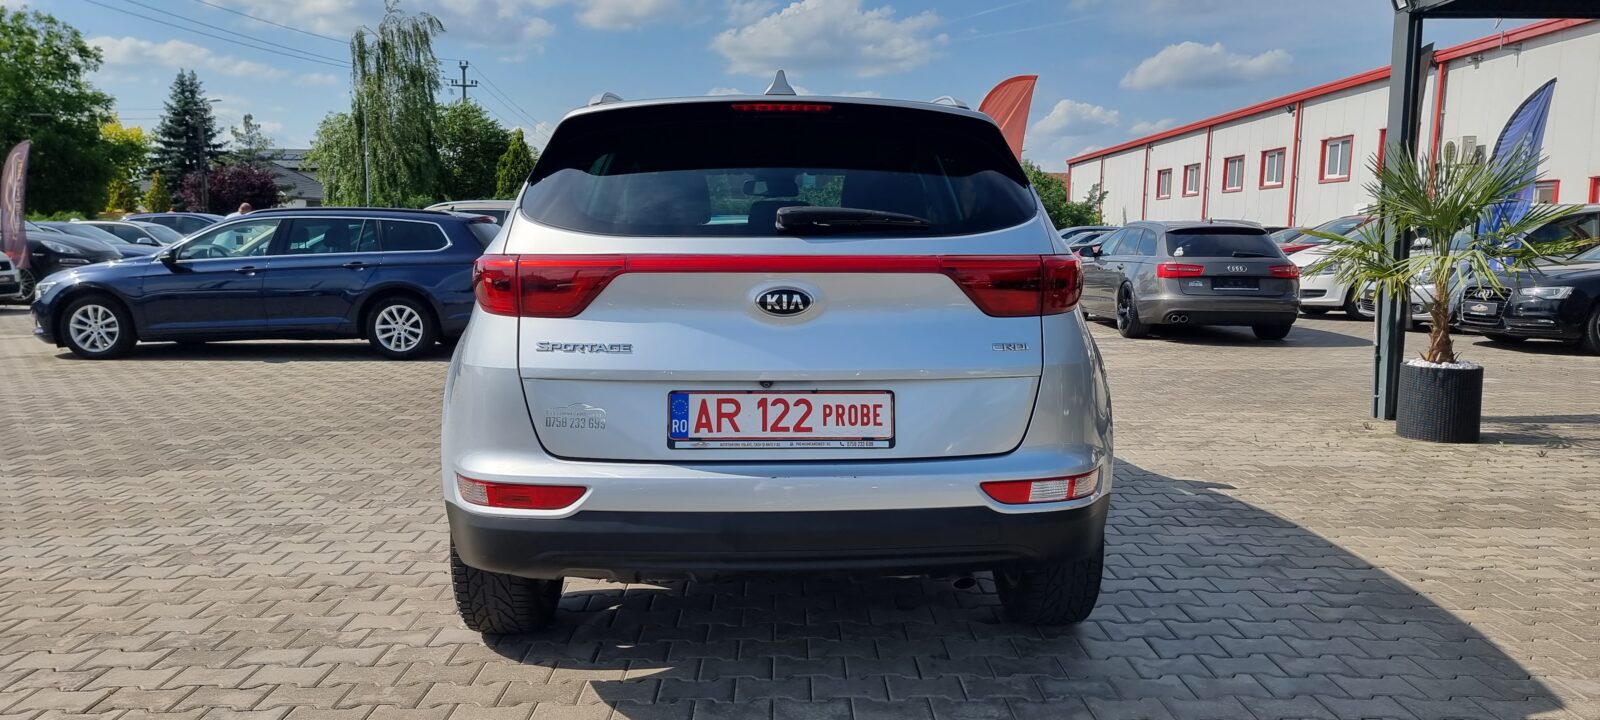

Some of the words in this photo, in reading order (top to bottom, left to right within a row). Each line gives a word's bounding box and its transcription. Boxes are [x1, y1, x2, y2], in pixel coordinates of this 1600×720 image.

[766, 294, 804, 309] KIA
[536, 342, 633, 354] SPORTAGE
[545, 416, 567, 428] 0758
[570, 417, 586, 429] 233
[694, 398, 741, 433] AR
[757, 398, 813, 433] 122
[822, 404, 883, 426] PROBE
[672, 419, 688, 433] RO
